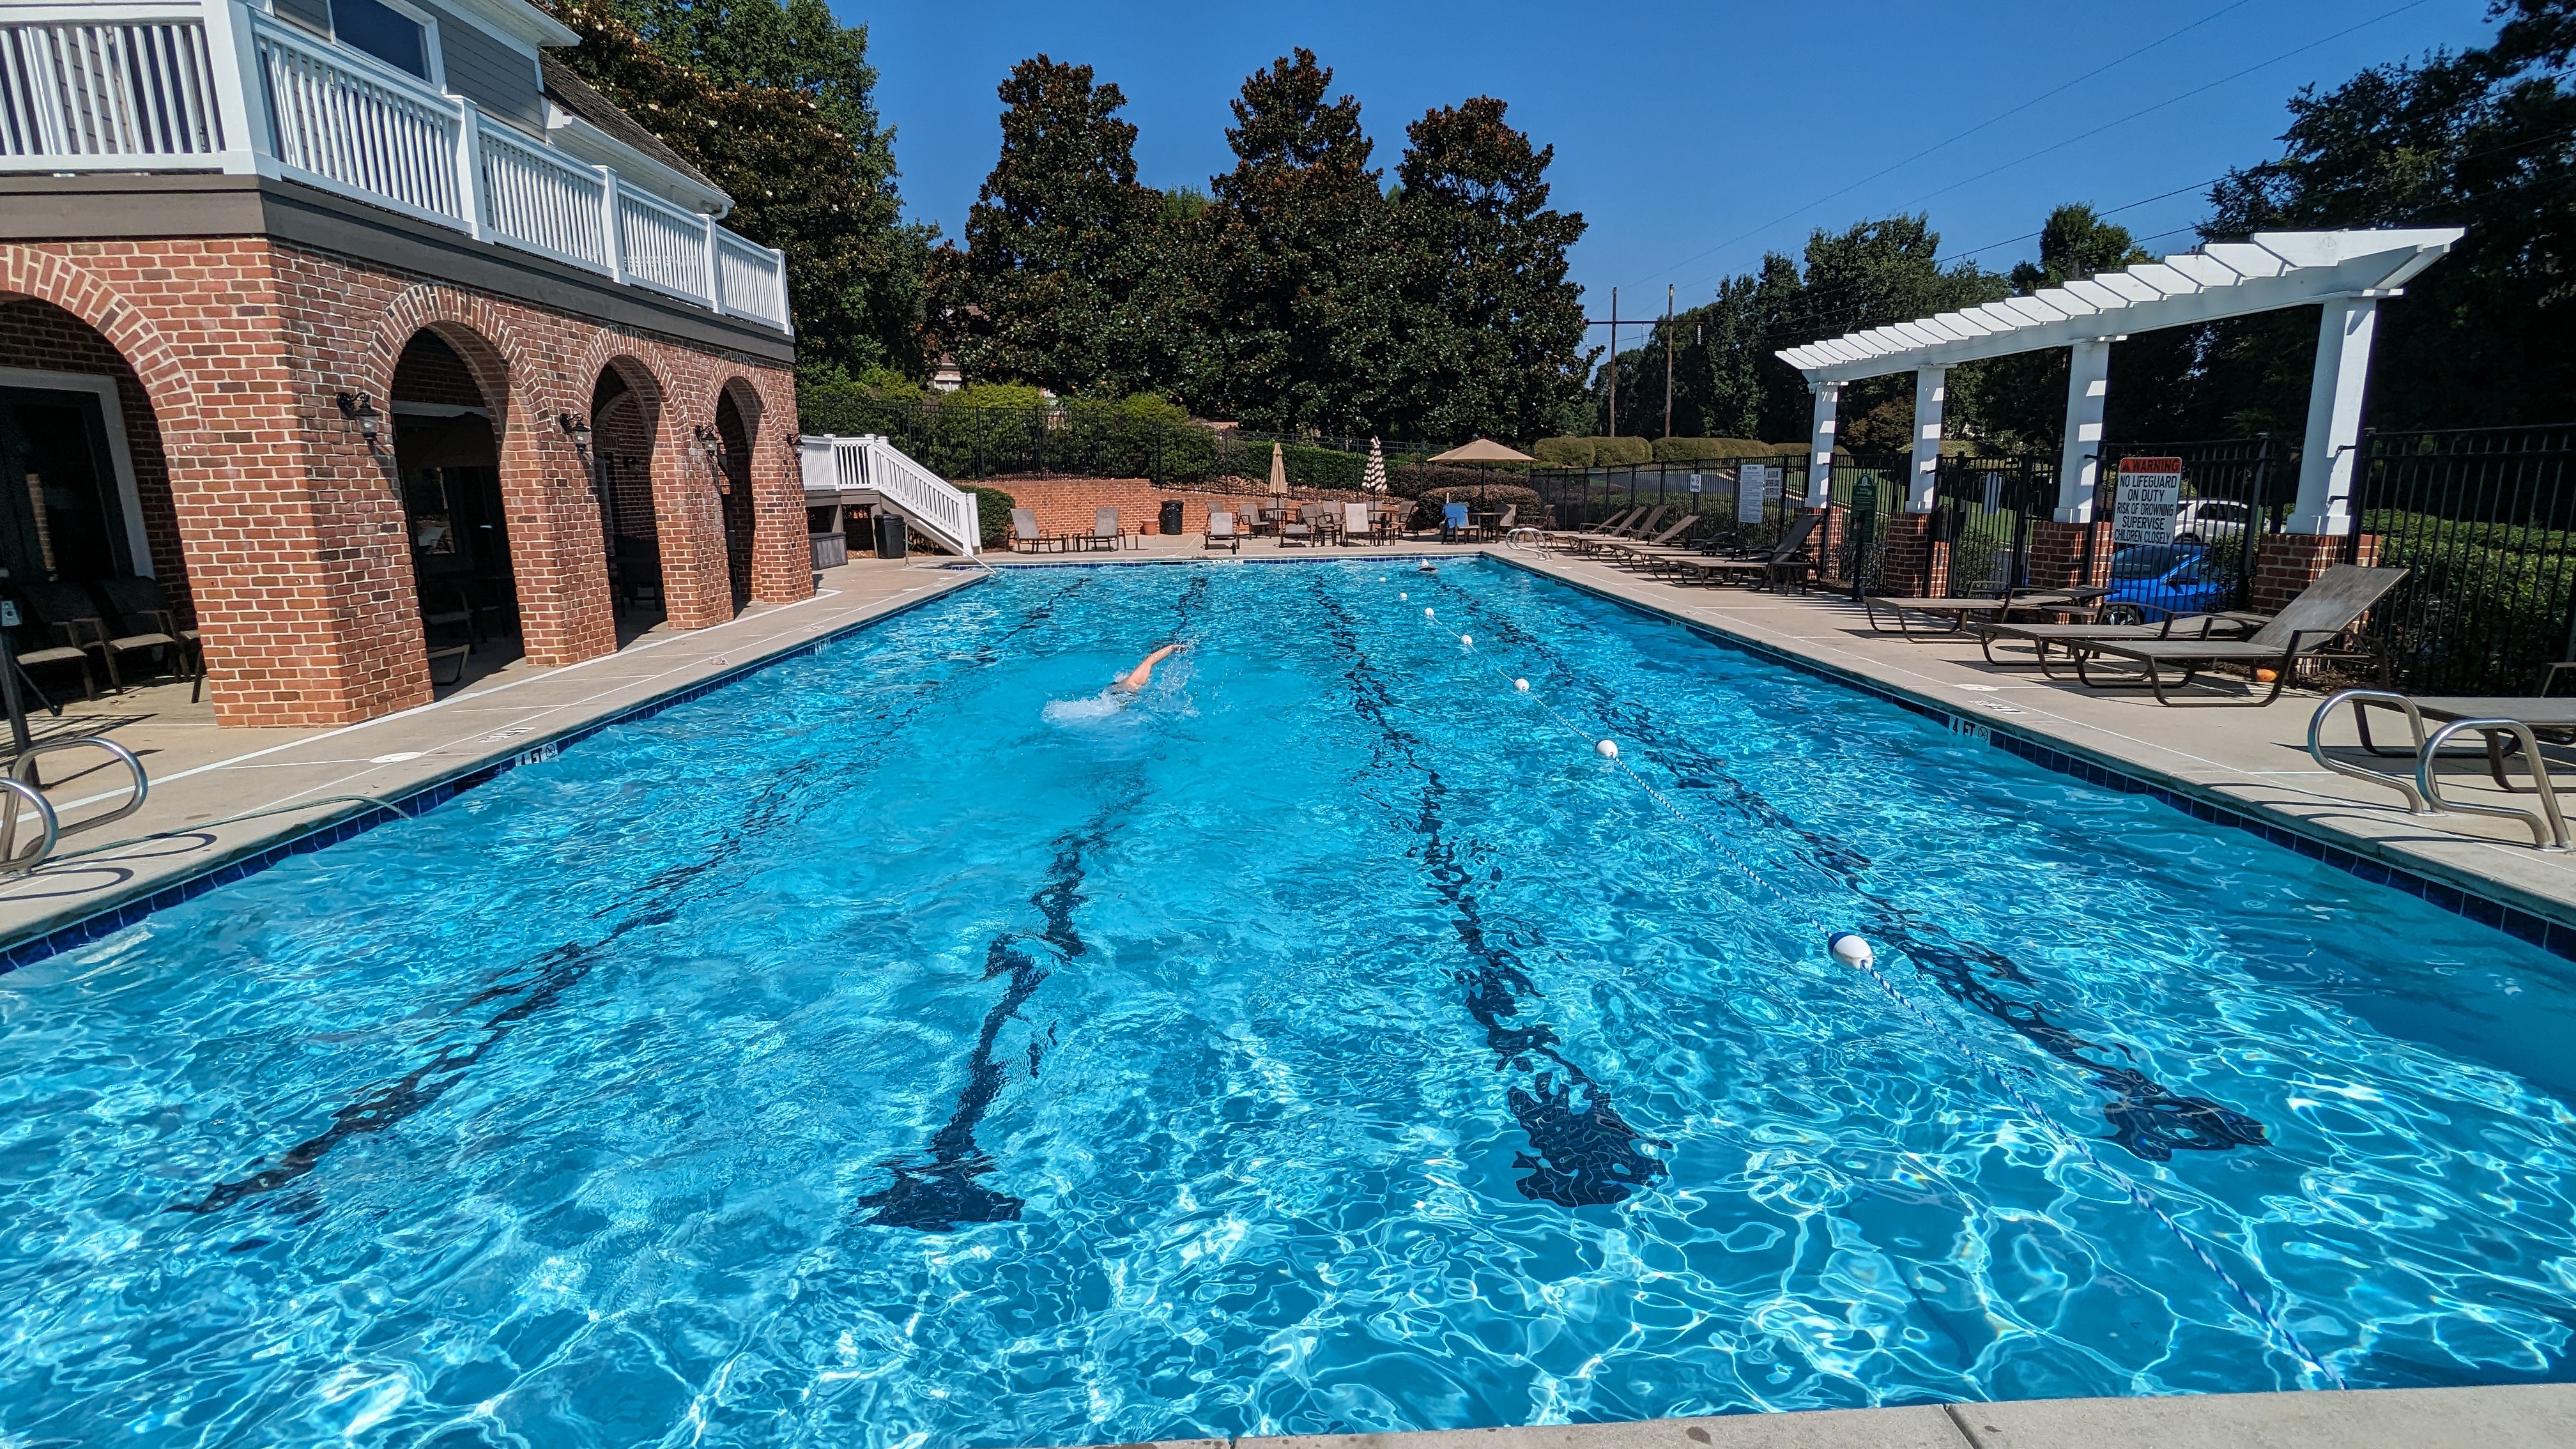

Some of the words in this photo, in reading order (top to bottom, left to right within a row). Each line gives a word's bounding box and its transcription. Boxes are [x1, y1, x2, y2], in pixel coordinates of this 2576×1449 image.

[2133, 459, 2179, 471] WARNING
[2120, 475, 2130, 487] NO
[2132, 475, 2177, 488] LIFEGUARD
[2128, 489, 2138, 502] ON
[2142, 489, 2165, 502] DUTY
[2117, 502, 2129, 514] RISK
[2131, 503, 2138, 515] OF
[2140, 503, 2174, 517] DROWNING
[2122, 516, 2166, 530] SUPERVISE
[2114, 528, 2143, 542] CHILDREN
[2144, 530, 2170, 545] CLOSELY
[1952, 717, 1959, 733] 4
[1963, 720, 1976, 737] FT
[530, 747, 542, 763] FT
